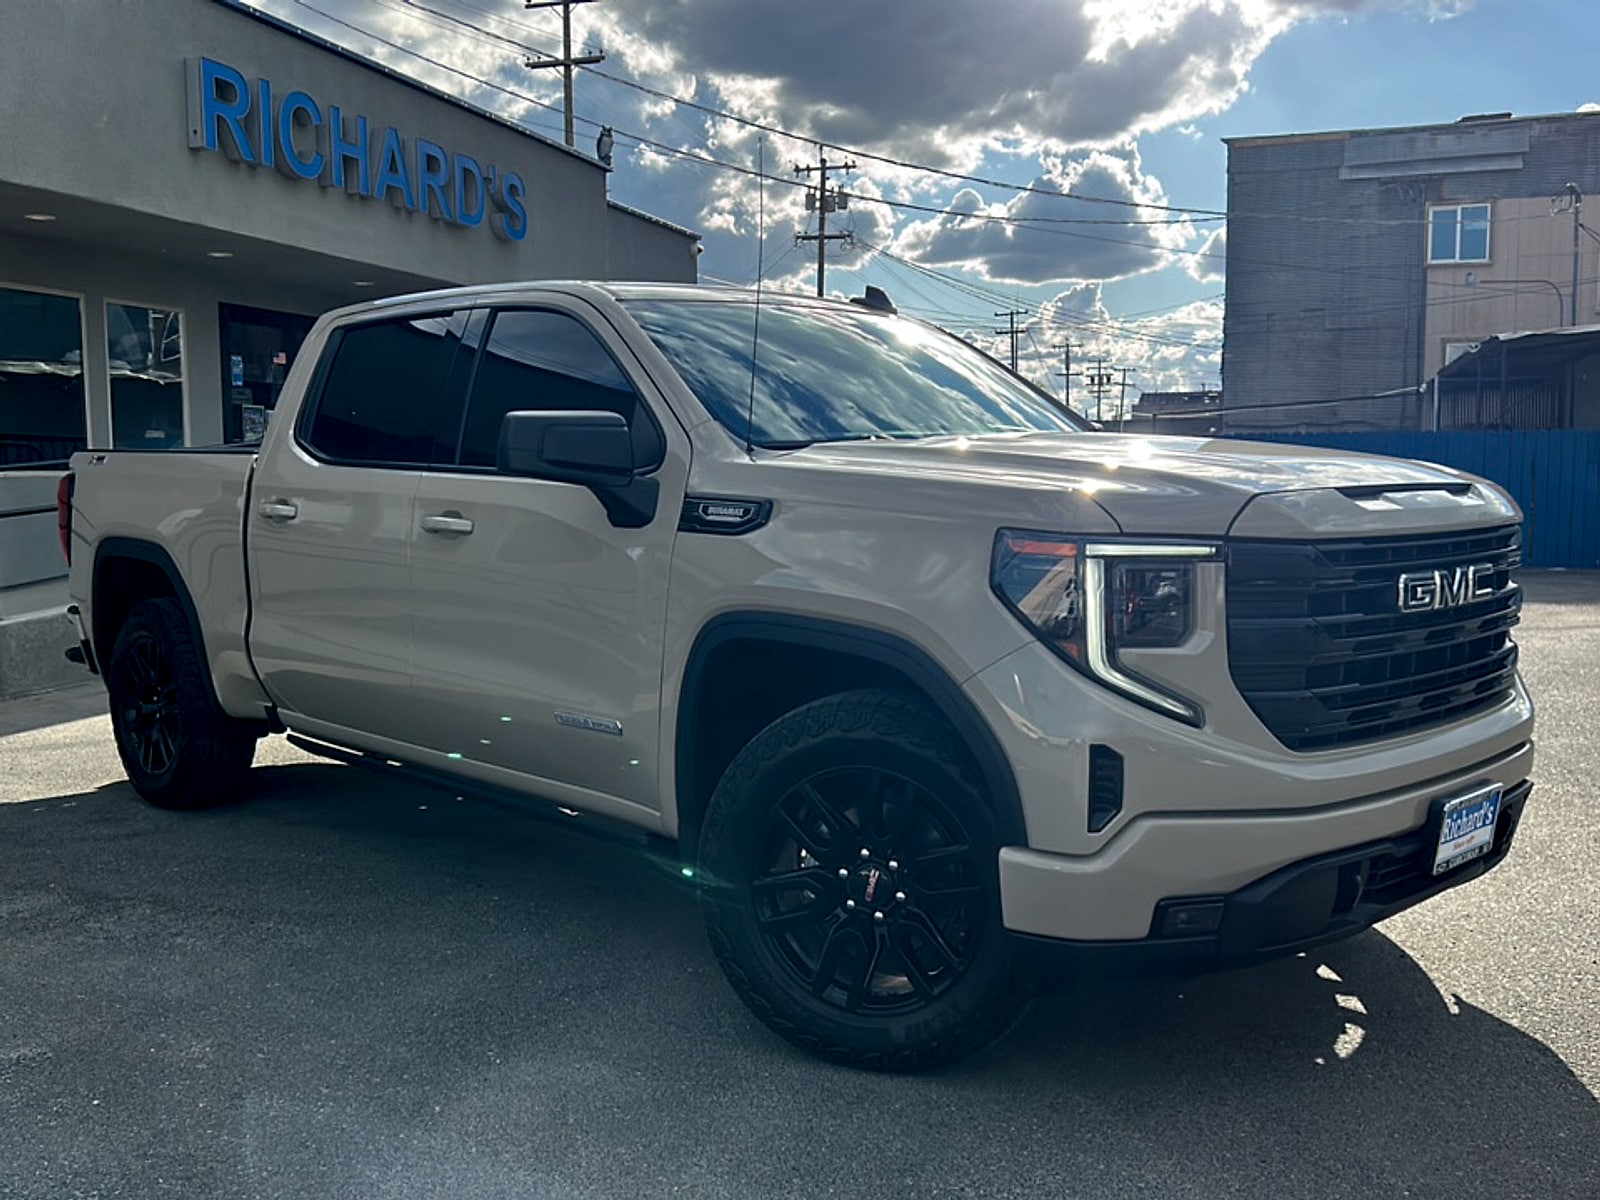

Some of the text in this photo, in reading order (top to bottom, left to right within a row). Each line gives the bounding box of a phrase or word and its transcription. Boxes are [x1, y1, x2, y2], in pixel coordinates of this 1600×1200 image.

[198, 56, 528, 241] RICHARD'S
[1398, 563, 1494, 613] GMC
[1441, 801, 1494, 843] Richard's
